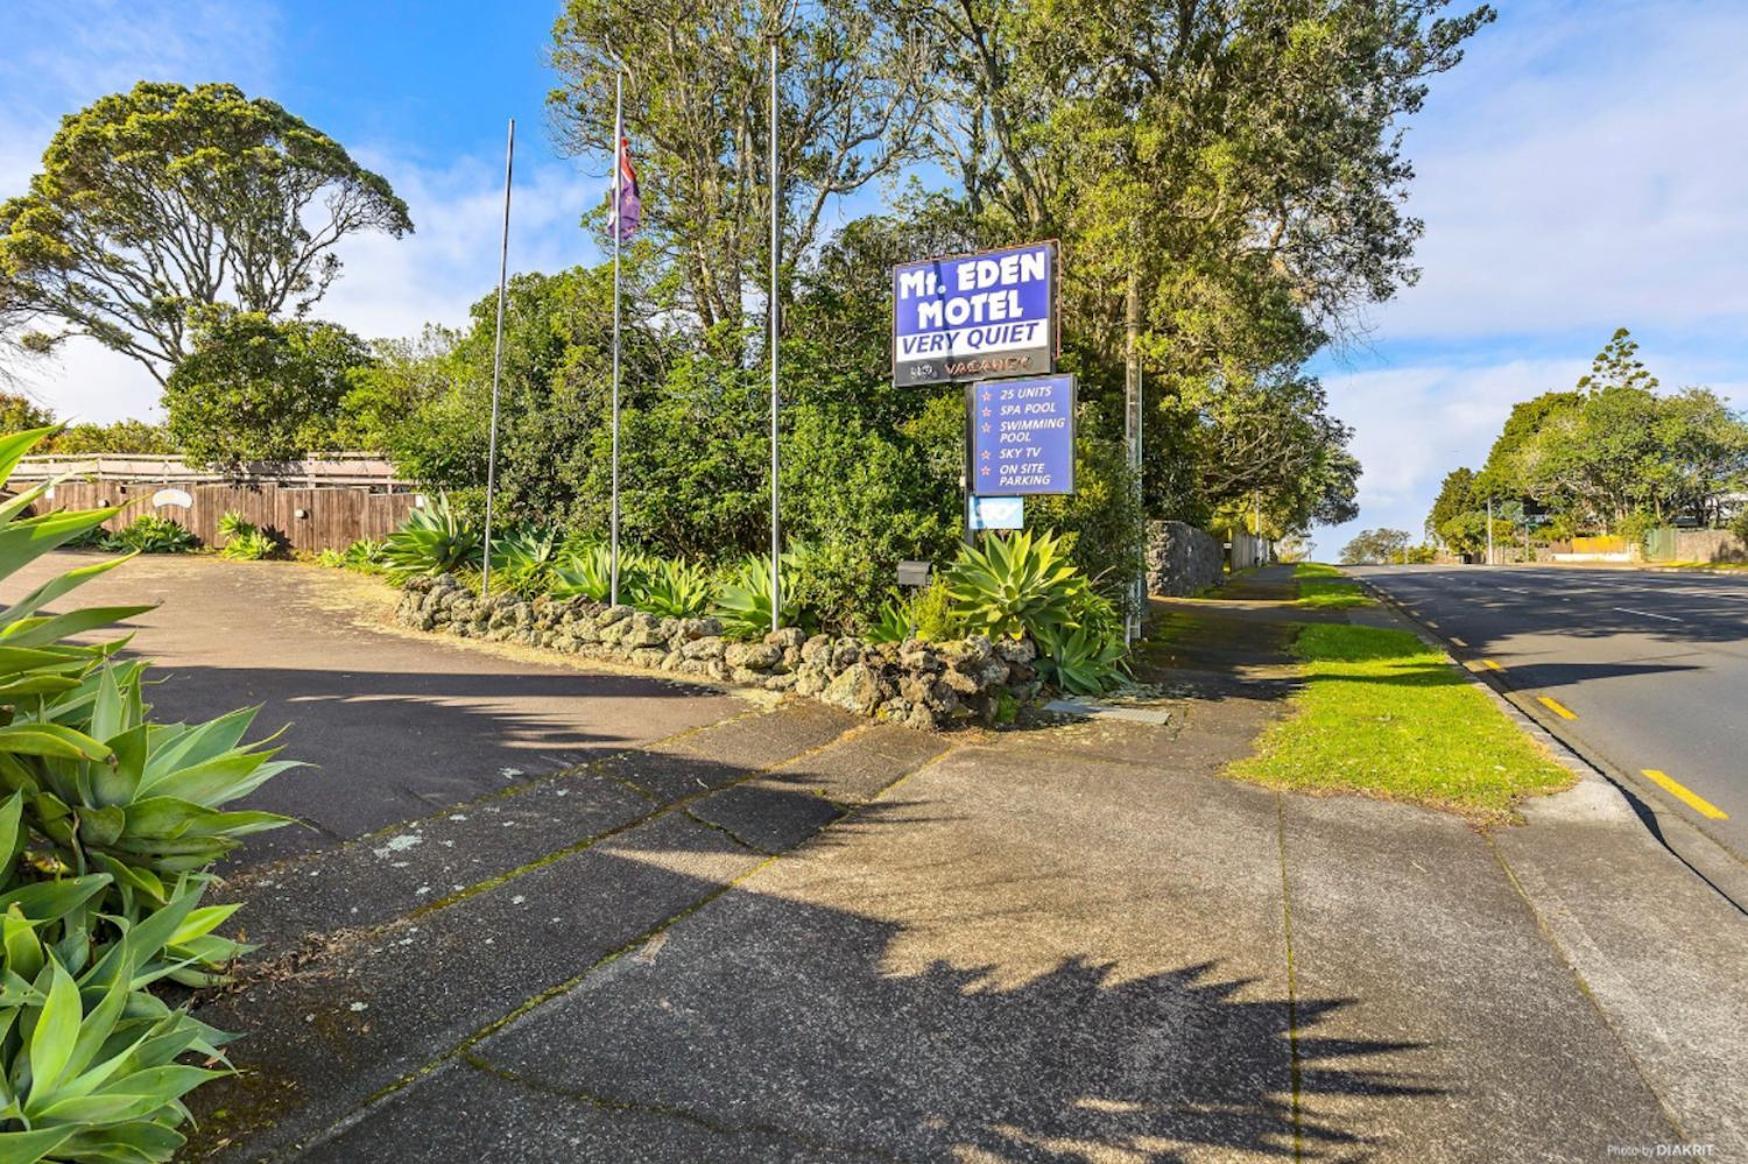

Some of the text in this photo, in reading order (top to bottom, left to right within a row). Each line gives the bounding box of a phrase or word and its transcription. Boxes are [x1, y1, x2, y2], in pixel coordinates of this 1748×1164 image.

[900, 252, 1046, 299] Mt. EDEN
[918, 290, 1023, 330] MOTEL
[903, 322, 1039, 355] VERY QUIET
[1001, 386, 1051, 400] 25 UNITS
[1001, 402, 1056, 416] SPA POOL
[1001, 418, 1065, 432] SWIMMING
[1001, 432, 1031, 443] POOL
[1000, 448, 1041, 460] SKY TV
[1000, 463, 1044, 475] ON SITE
[1000, 476, 1050, 487] PARKING
